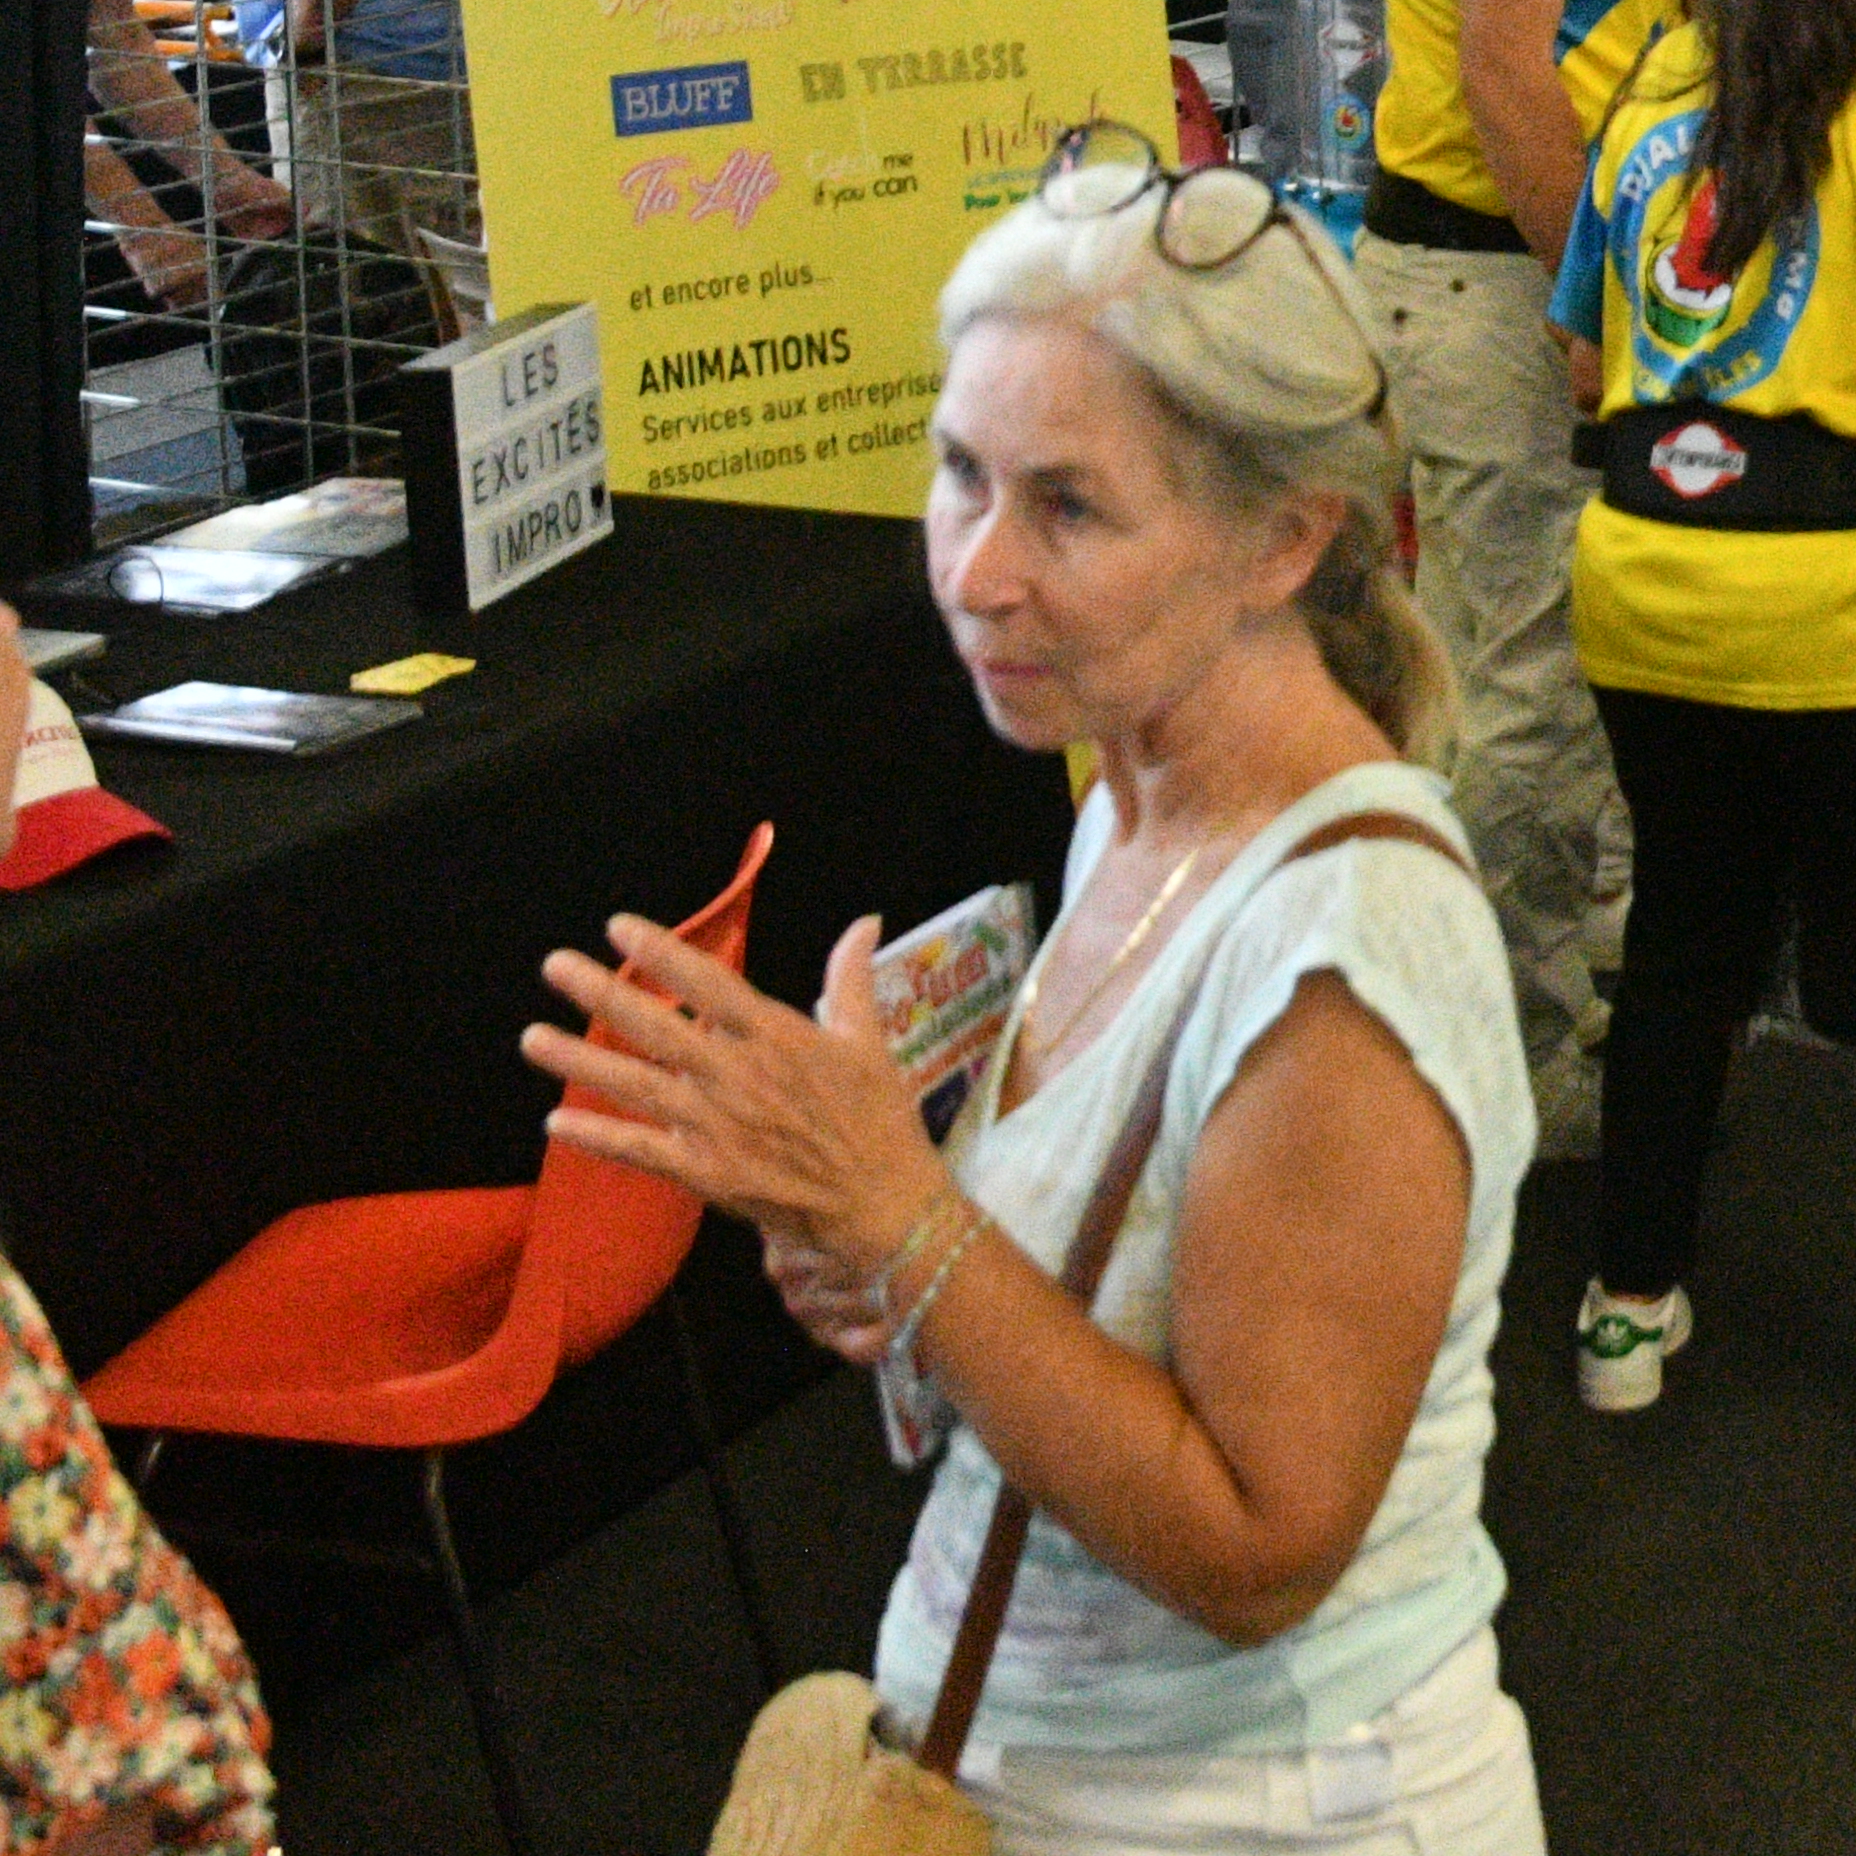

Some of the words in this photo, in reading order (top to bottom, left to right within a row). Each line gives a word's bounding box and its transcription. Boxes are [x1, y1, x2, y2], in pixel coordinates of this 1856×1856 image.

[622, 73, 740, 123] BLUFF
[872, 175, 918, 198] can
[629, 288, 653, 312] et
[662, 272, 750, 306] encore
[501, 343, 559, 407] LES
[639, 328, 852, 397] ANIMATIONS
[641, 402, 753, 444] Services
[761, 394, 808, 422] aux
[815, 370, 943, 415] entreprise
[646, 439, 807, 492] associations
[815, 435, 841, 460] et
[847, 417, 932, 455] collect
[493, 489, 583, 574] IMPRO
